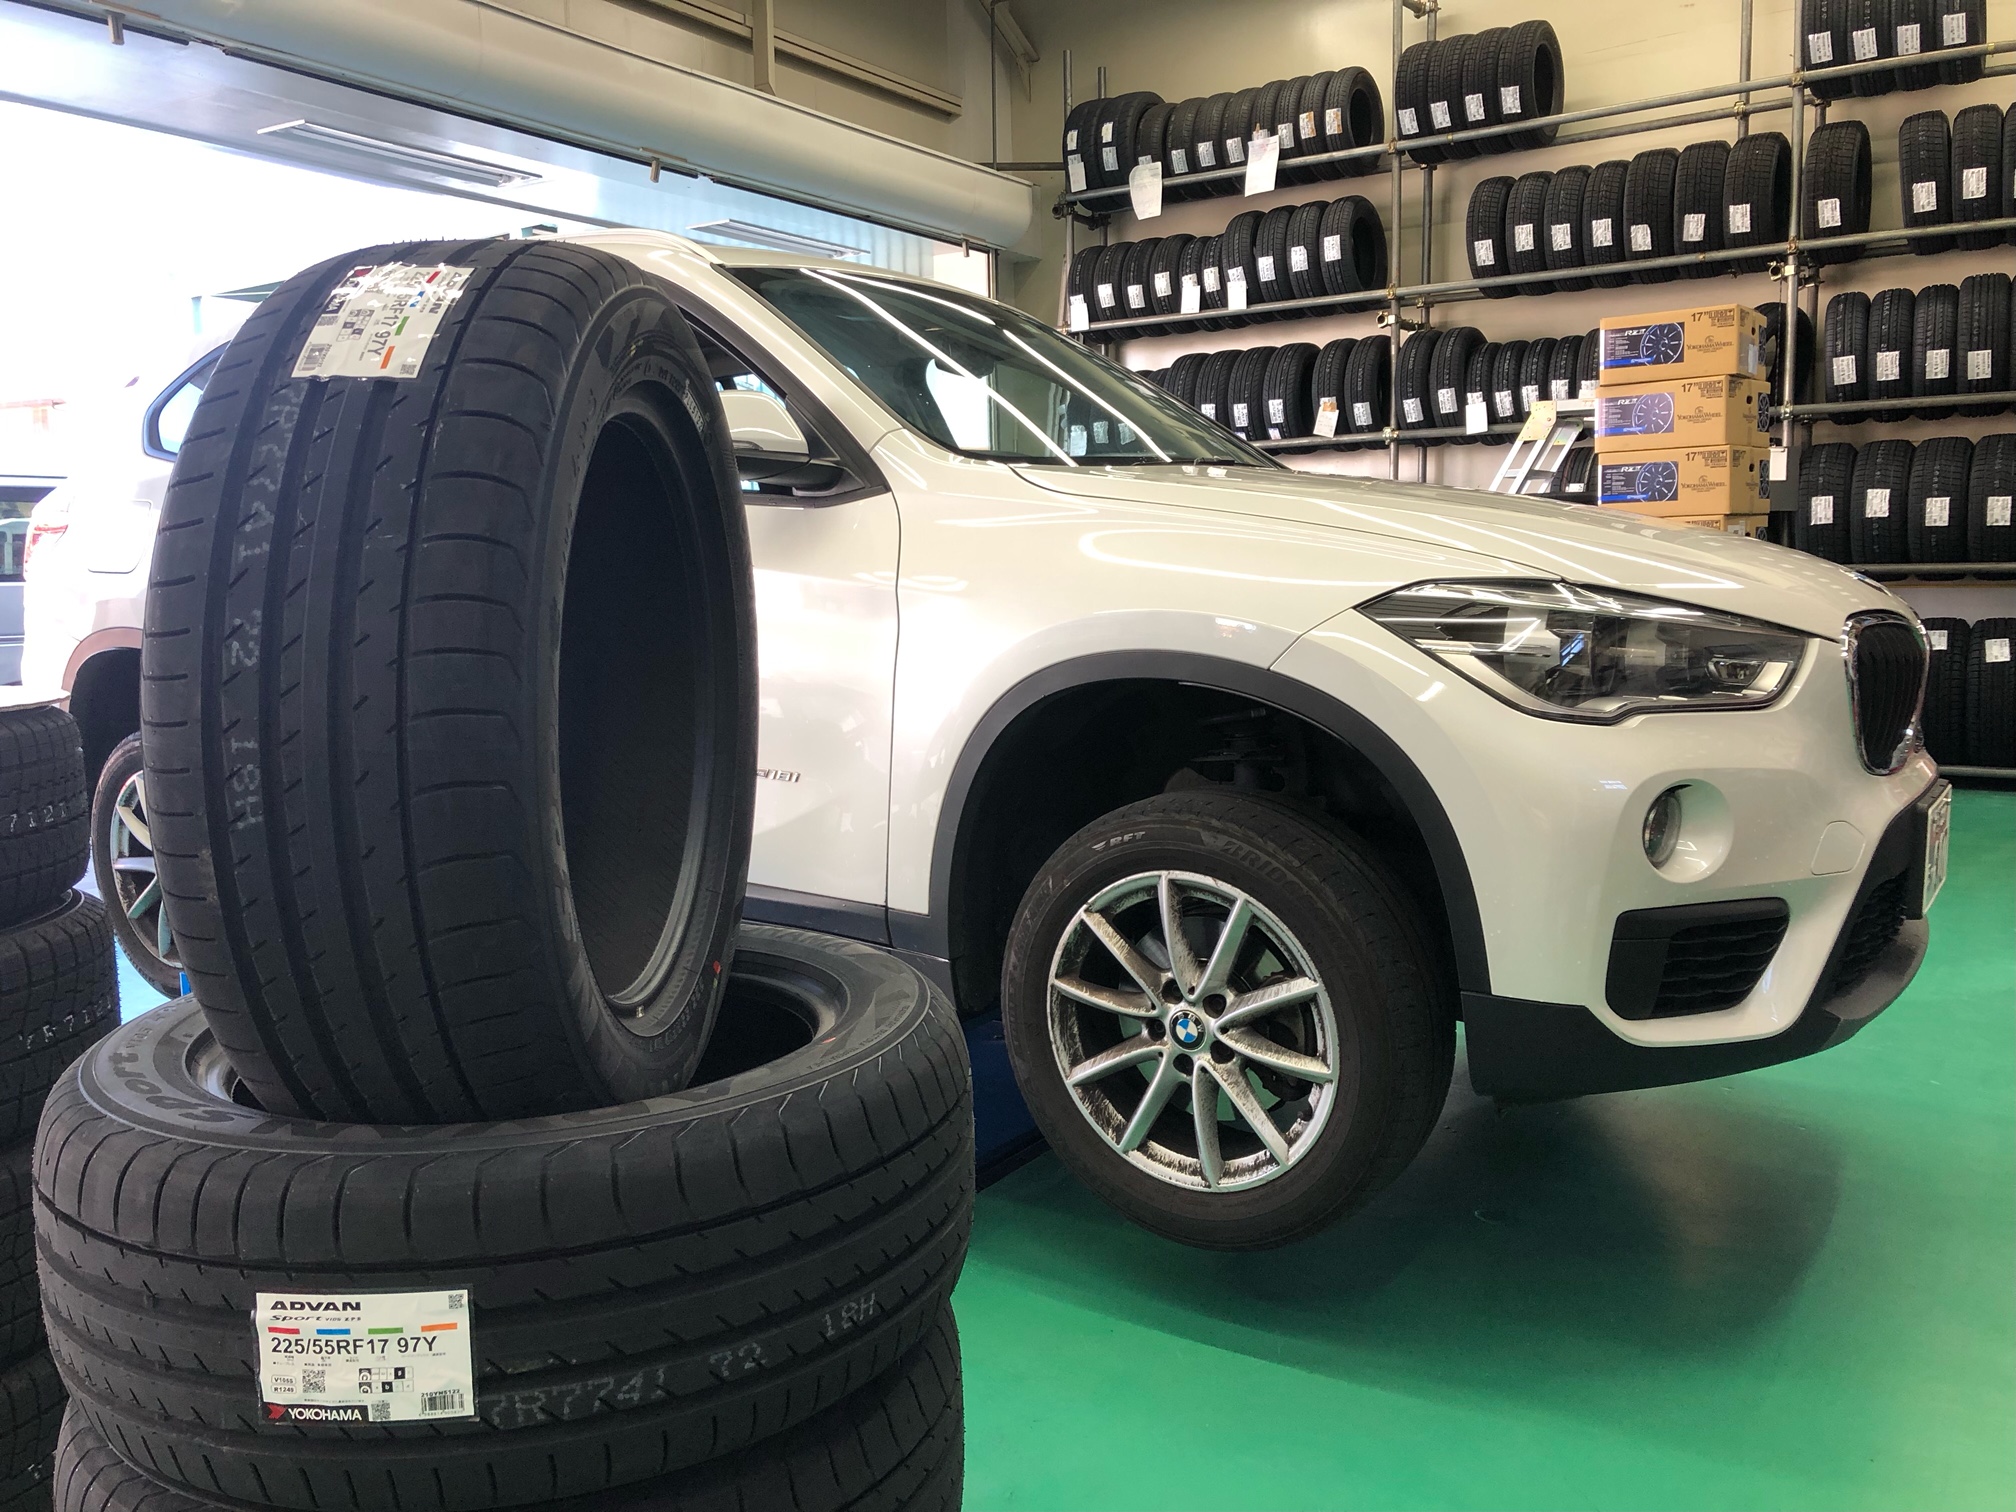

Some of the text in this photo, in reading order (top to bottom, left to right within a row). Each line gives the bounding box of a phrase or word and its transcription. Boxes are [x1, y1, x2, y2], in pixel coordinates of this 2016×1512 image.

[1177, 1011, 1204, 1033] BMW
[270, 1300, 362, 1312] ADVAN
[397, 1335, 438, 1354] 97Y
[288, 1407, 363, 1421] YOKOHAMA
